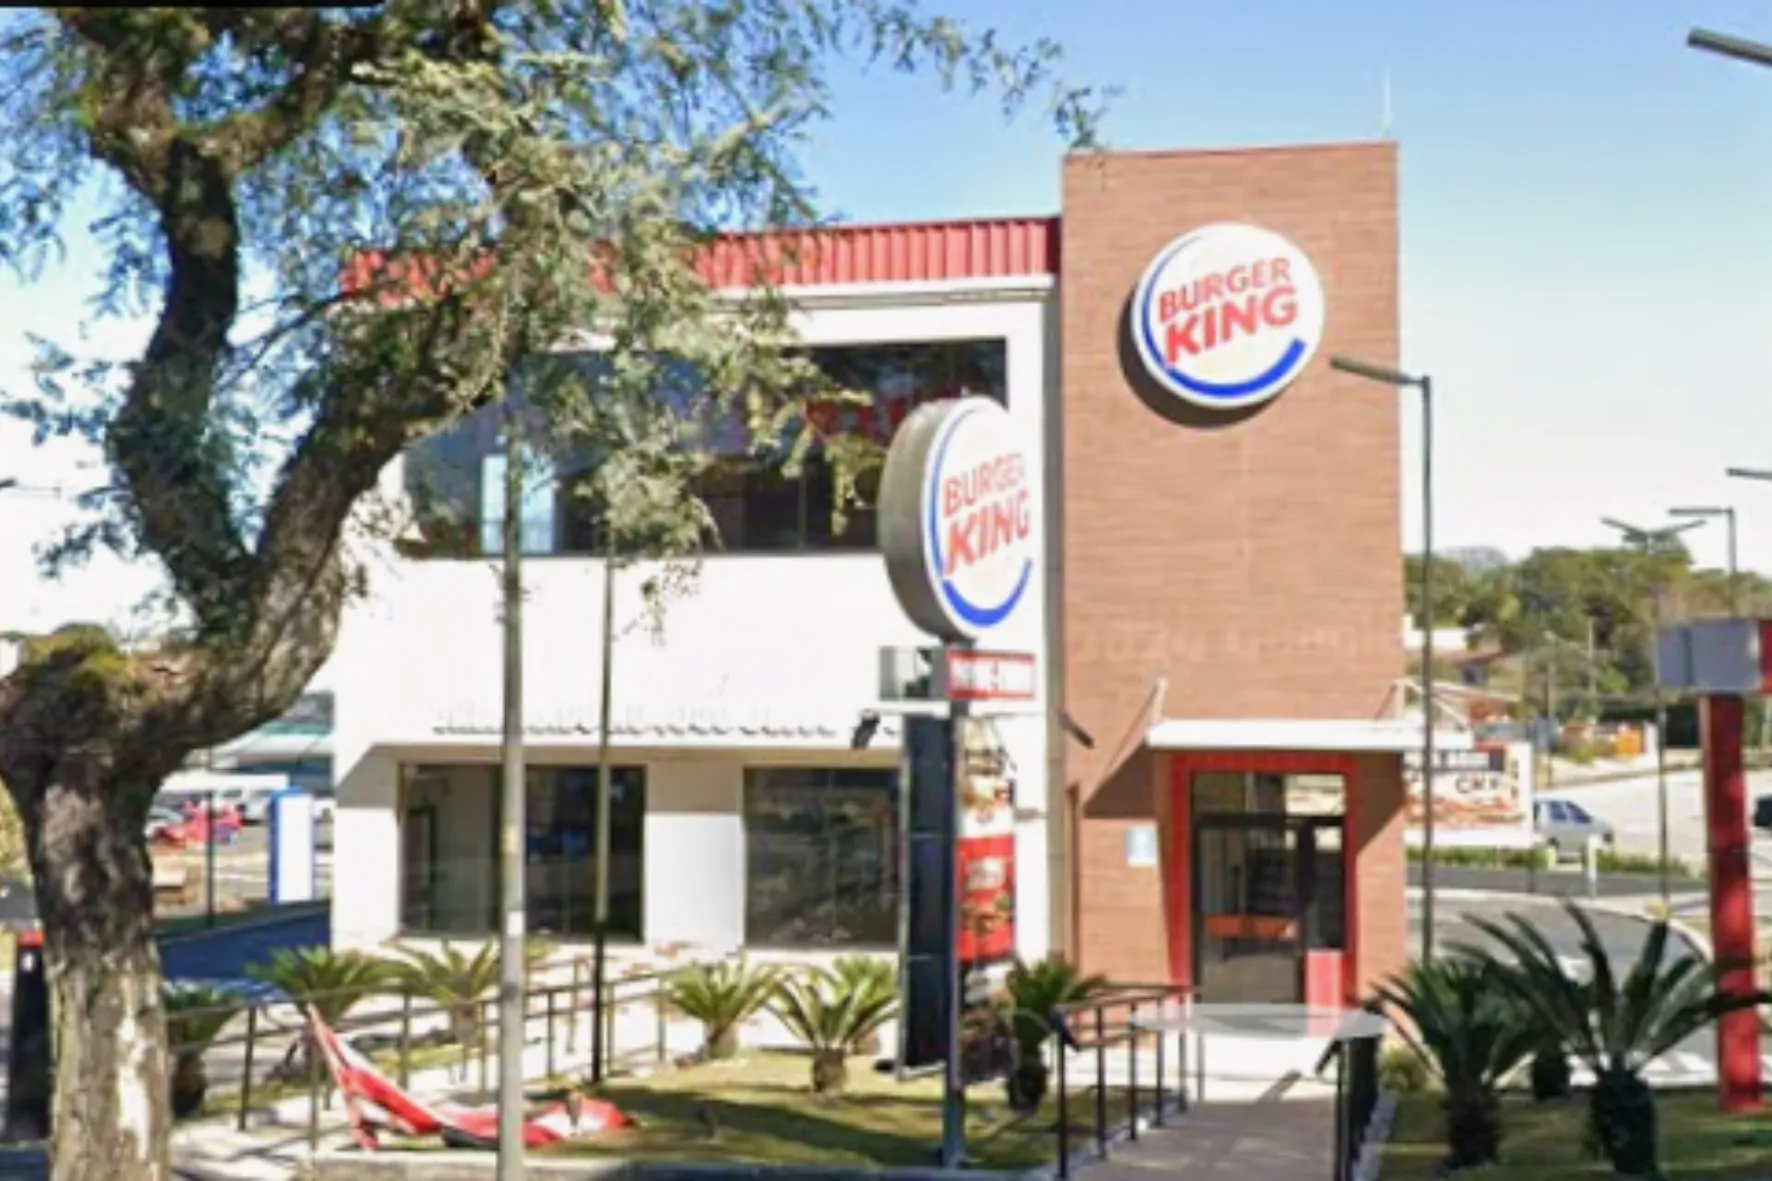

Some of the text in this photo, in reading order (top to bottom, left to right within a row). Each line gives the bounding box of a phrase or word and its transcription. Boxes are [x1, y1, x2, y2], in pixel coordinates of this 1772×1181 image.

[1160, 257, 1290, 322] BURGER
[1165, 285, 1298, 362] KING
[946, 488, 1030, 575] KING
